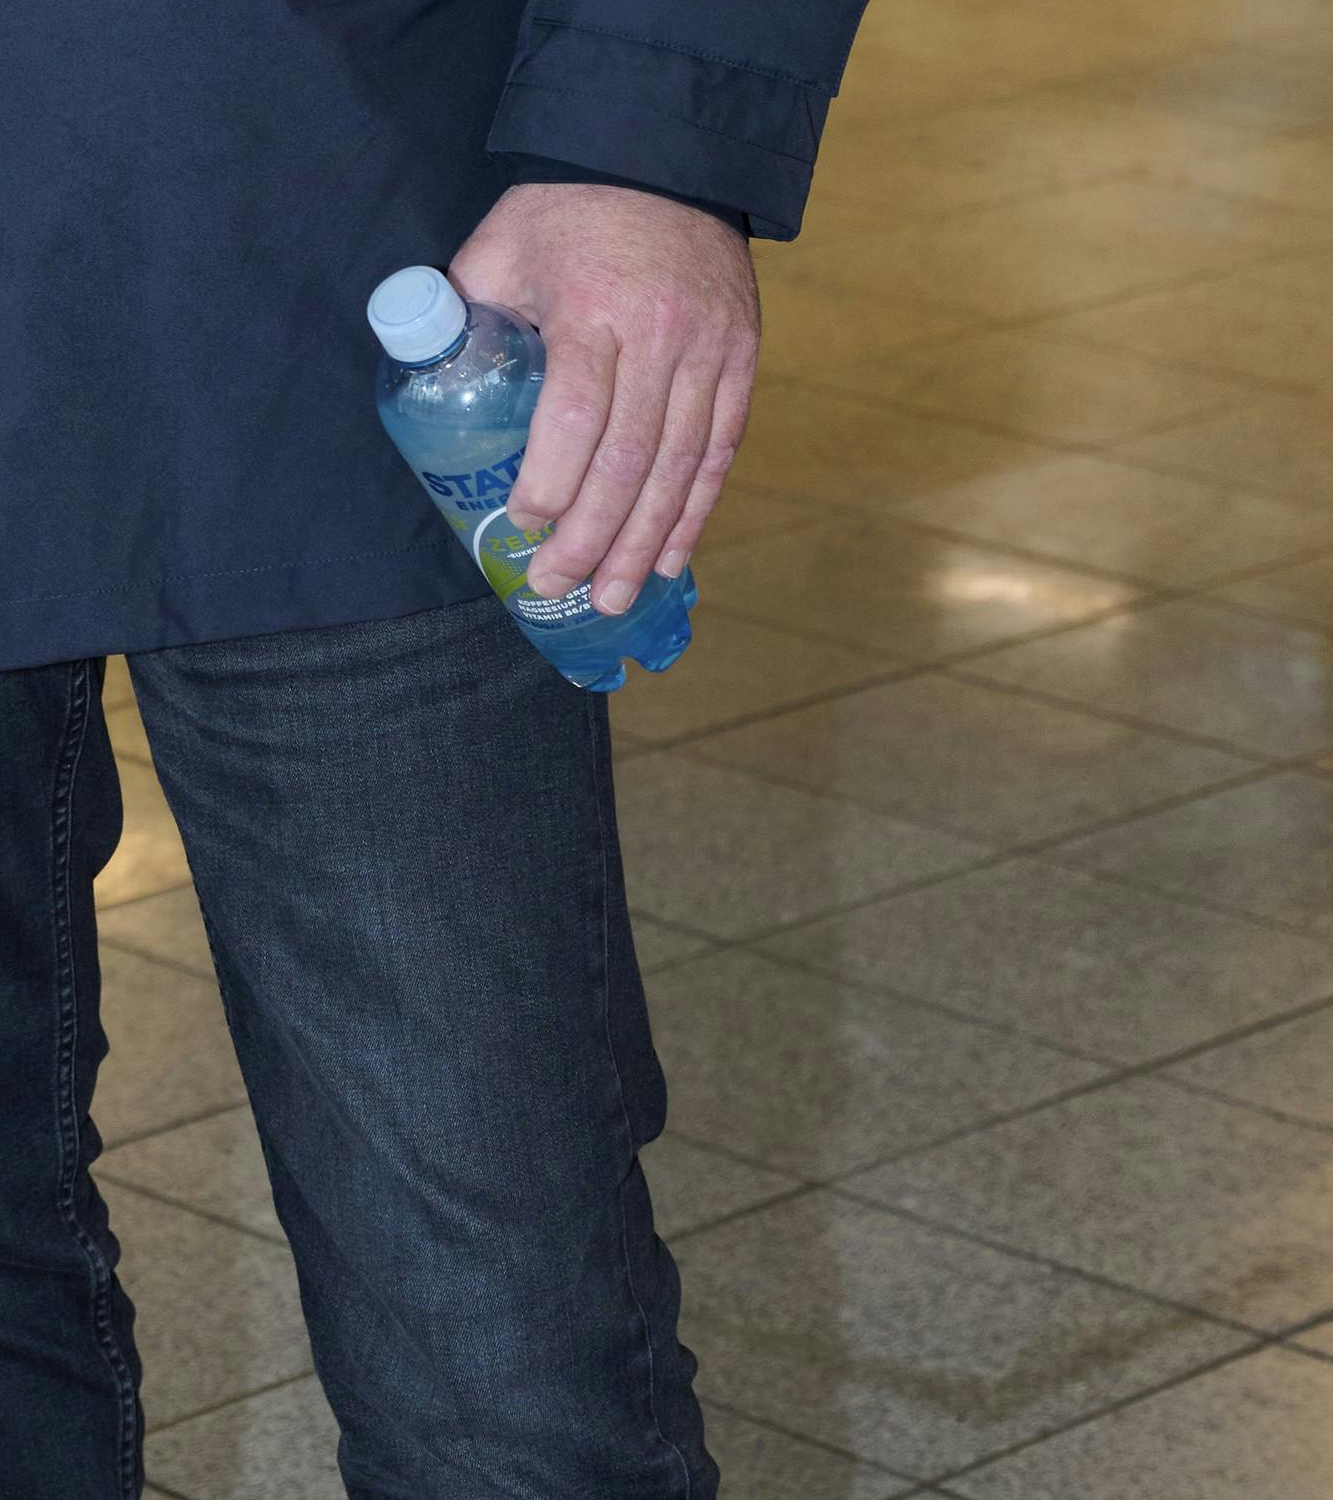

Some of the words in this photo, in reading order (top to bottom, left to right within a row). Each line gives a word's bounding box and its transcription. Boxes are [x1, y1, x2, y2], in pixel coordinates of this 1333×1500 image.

[421, 446, 526, 498] STAT
[457, 494, 509, 511] ENER
[517, 599, 578, 614] MAGNESIUM
[522, 611, 563, 621] VITAMIN
[564, 600, 593, 618] B6/B
